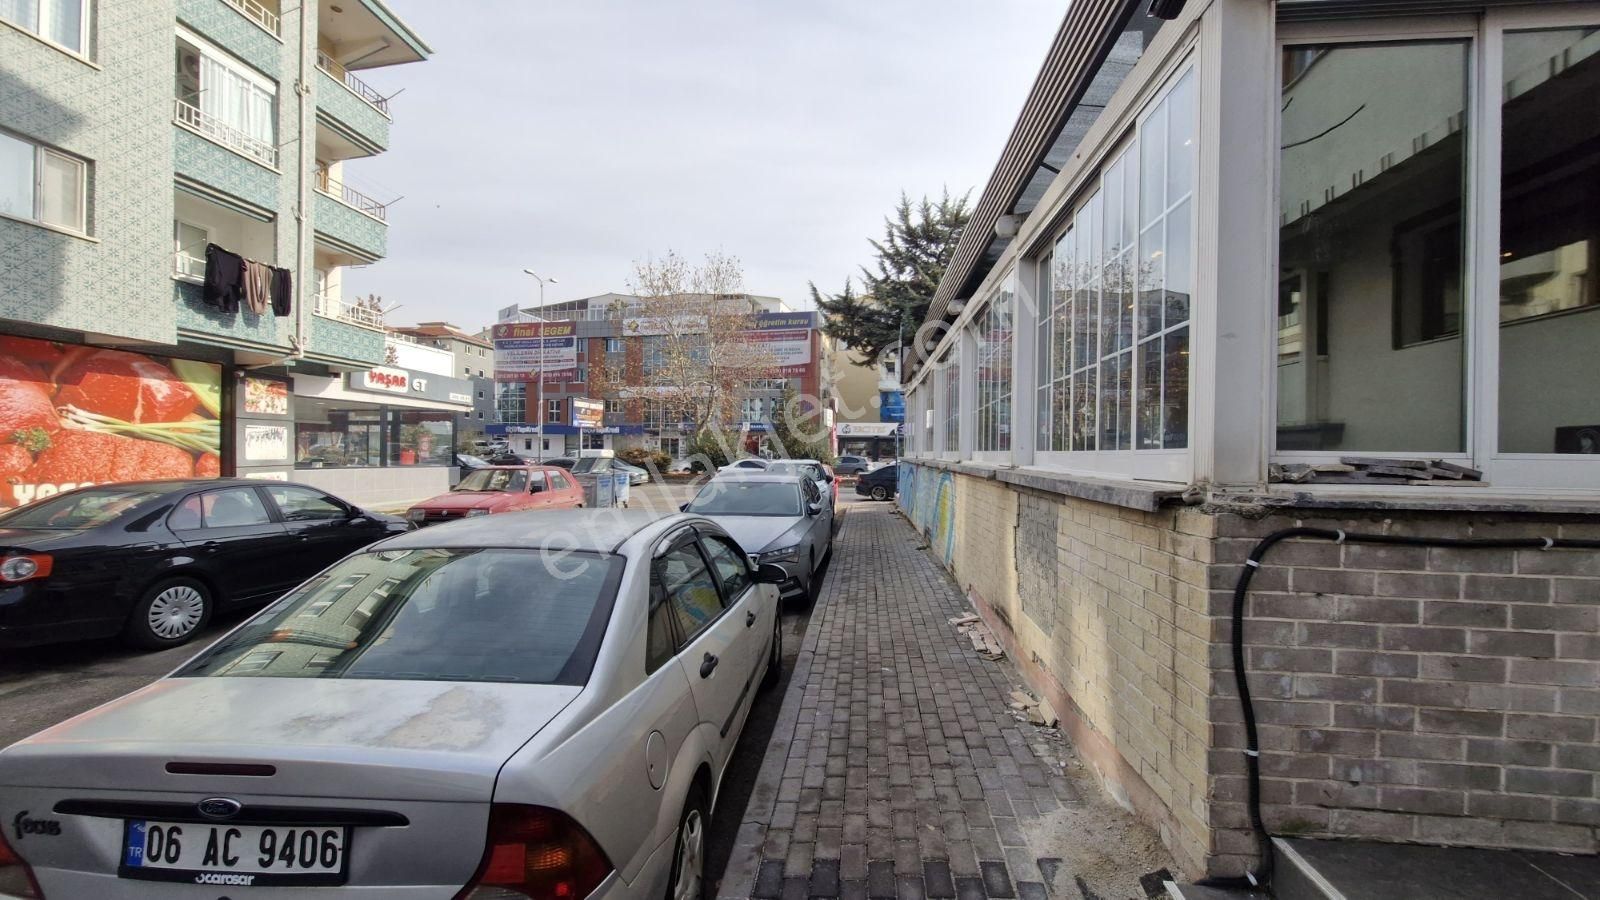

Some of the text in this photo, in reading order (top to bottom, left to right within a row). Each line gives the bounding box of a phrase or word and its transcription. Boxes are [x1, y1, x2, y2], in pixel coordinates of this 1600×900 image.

[369, 371, 406, 388] YAŞAR
[129, 846, 143, 858] TR
[146, 825, 339, 868] 06 AC 9406
